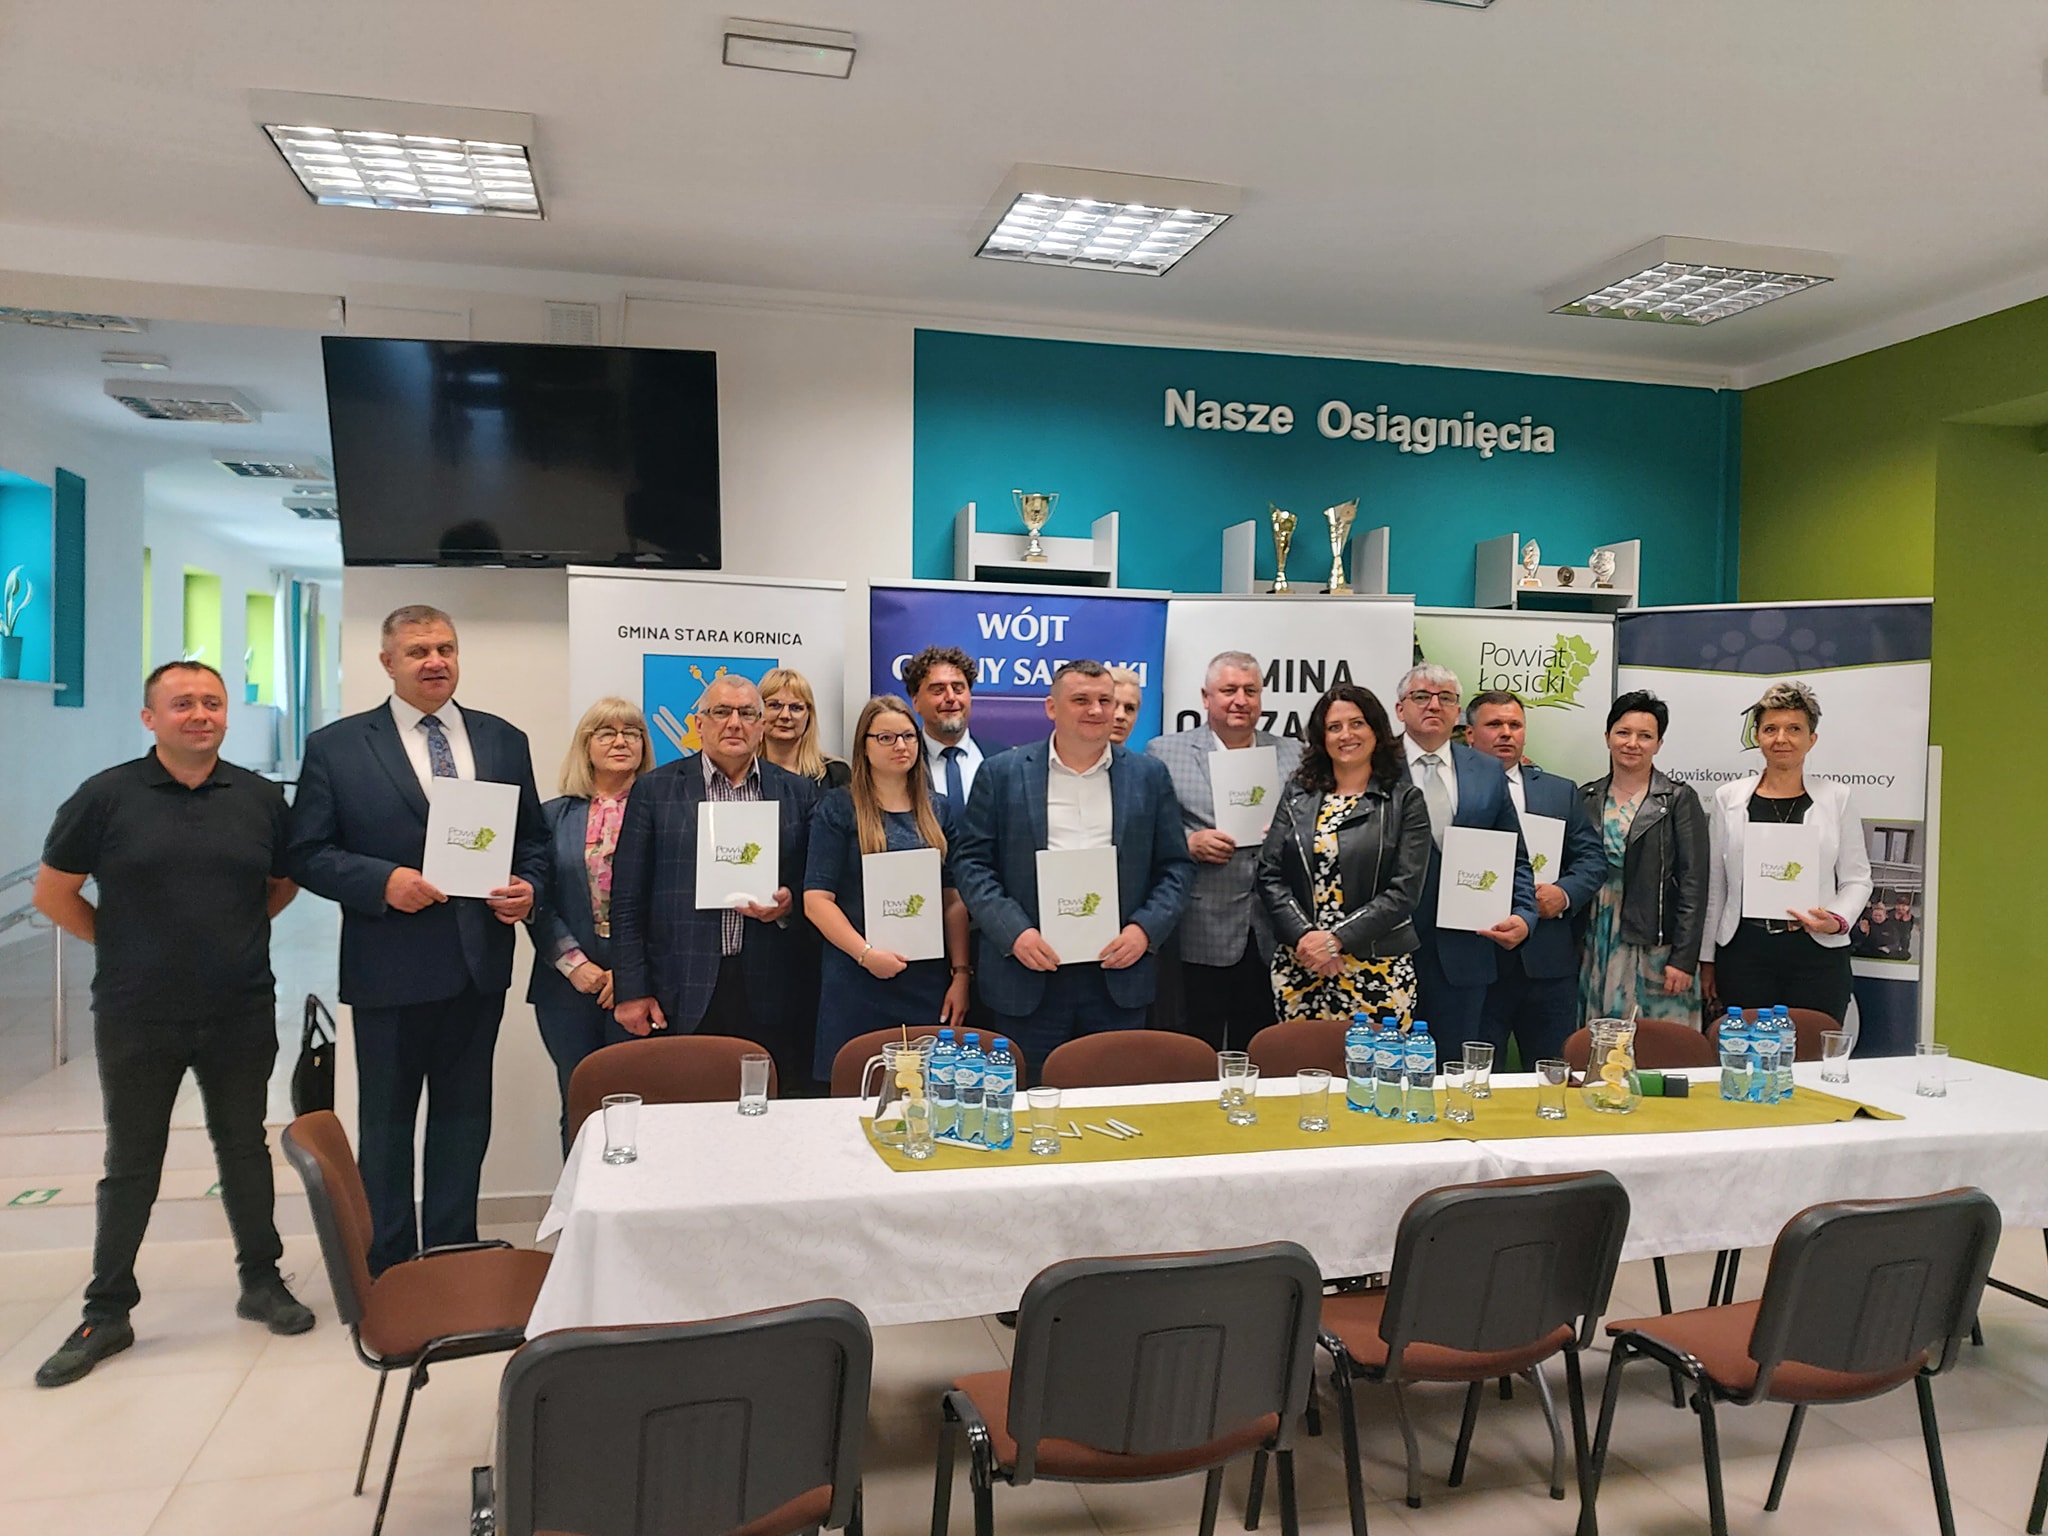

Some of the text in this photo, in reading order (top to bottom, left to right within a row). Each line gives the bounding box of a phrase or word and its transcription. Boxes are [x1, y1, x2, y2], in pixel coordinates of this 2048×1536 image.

[1164, 388, 1555, 458] Nasze Osiągnięcia
[617, 625, 803, 646] GMINA STARA KORNICA
[977, 606, 1070, 647] WÓJT
[1480, 641, 1567, 668] Powiat
[1263, 659, 1354, 693] MINA
[1478, 667, 1566, 693] Łosicki
[1666, 768, 1743, 782] dowiskowy
